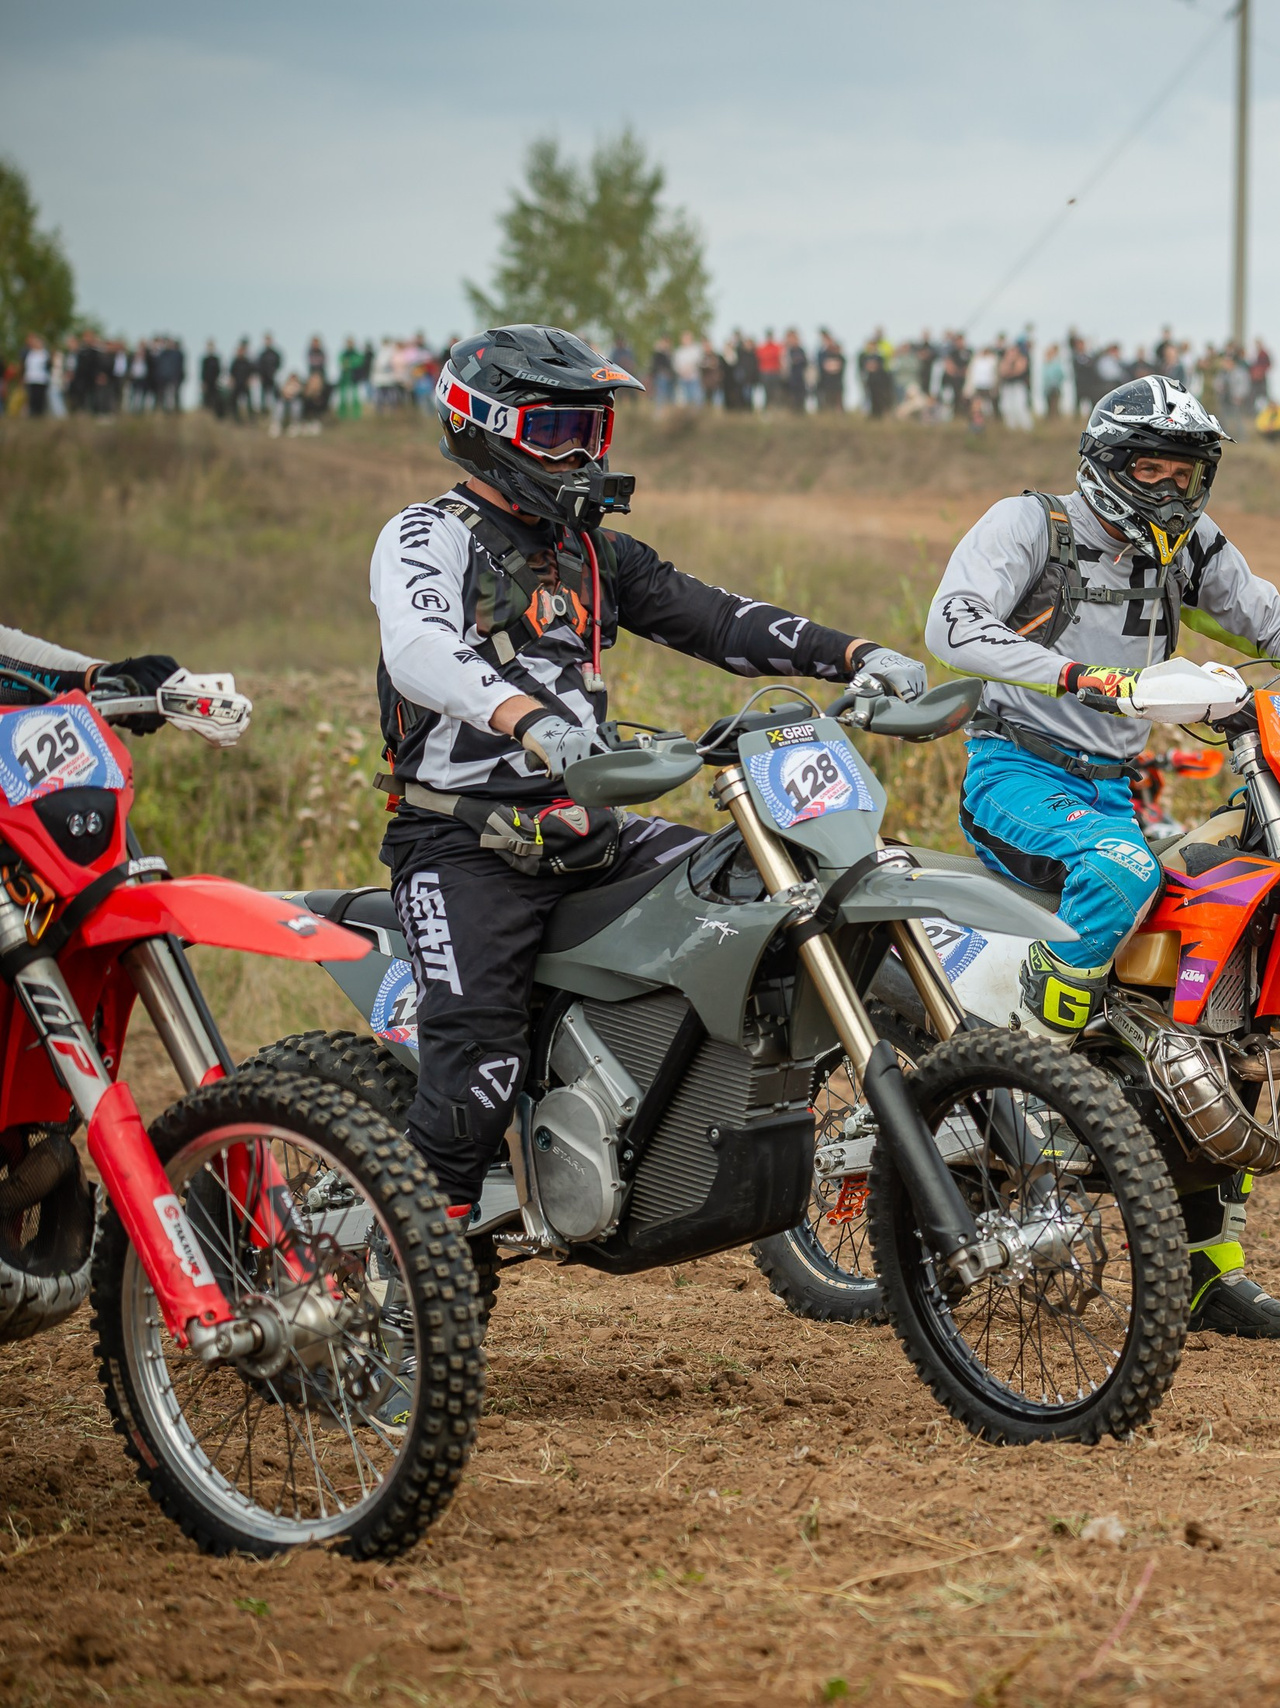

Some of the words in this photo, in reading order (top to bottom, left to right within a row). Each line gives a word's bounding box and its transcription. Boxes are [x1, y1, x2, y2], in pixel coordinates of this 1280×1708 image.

[17, 719, 80, 788] 125
[766, 724, 815, 744] X-GRIP
[785, 753, 838, 813] 128
[410, 871, 464, 996] LEATT
[1180, 969, 1206, 983] KTM
[551, 1144, 589, 1176] STARK
